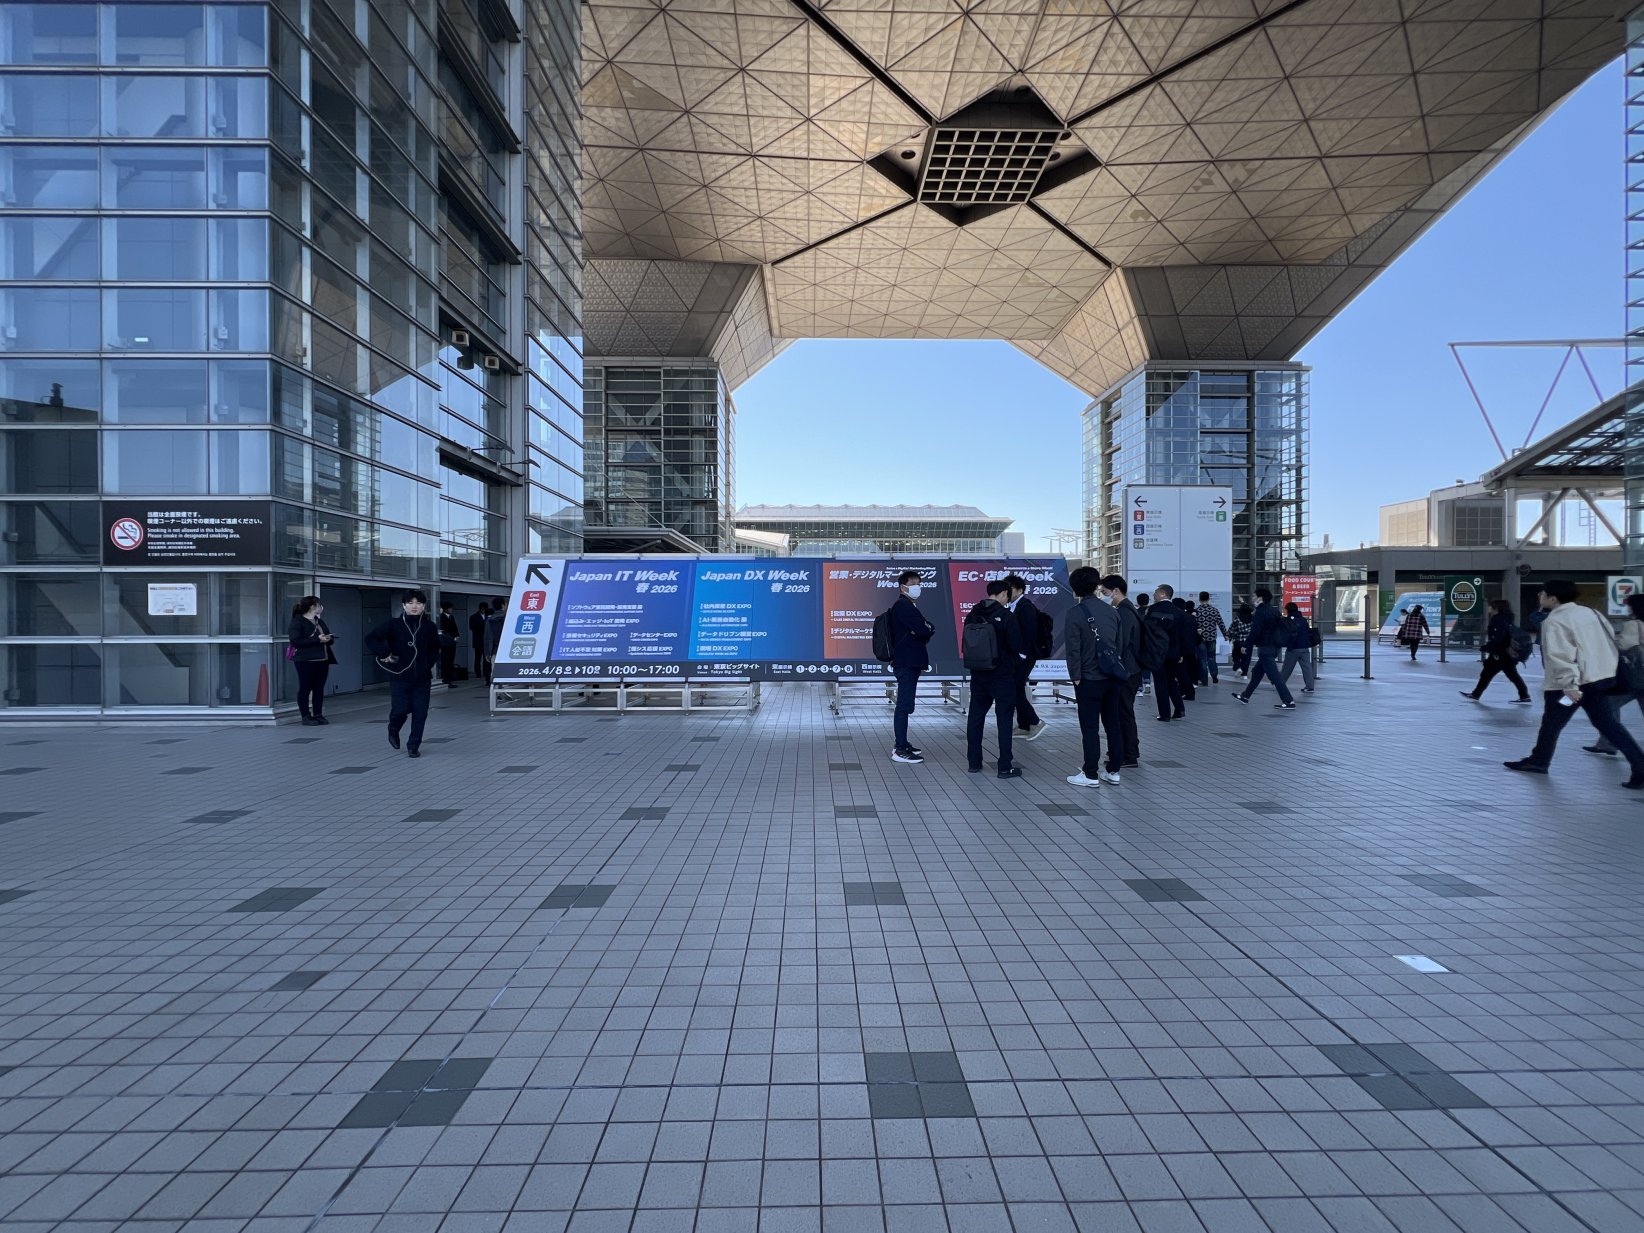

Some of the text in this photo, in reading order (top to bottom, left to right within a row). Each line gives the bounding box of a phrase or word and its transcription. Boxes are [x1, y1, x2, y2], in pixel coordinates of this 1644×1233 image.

[570, 570, 680, 582] Japan IT Week
[701, 570, 810, 582] Japan DX Week
[829, 570, 937, 579] 営業・デジタルマーング
[1014, 571, 1055, 582] Week
[635, 583, 678, 593] 春 2026
[770, 583, 810, 593] 春 2026
[527, 598, 539, 609] 東
[521, 622, 533, 633] 西
[511, 645, 533, 656] 会議
